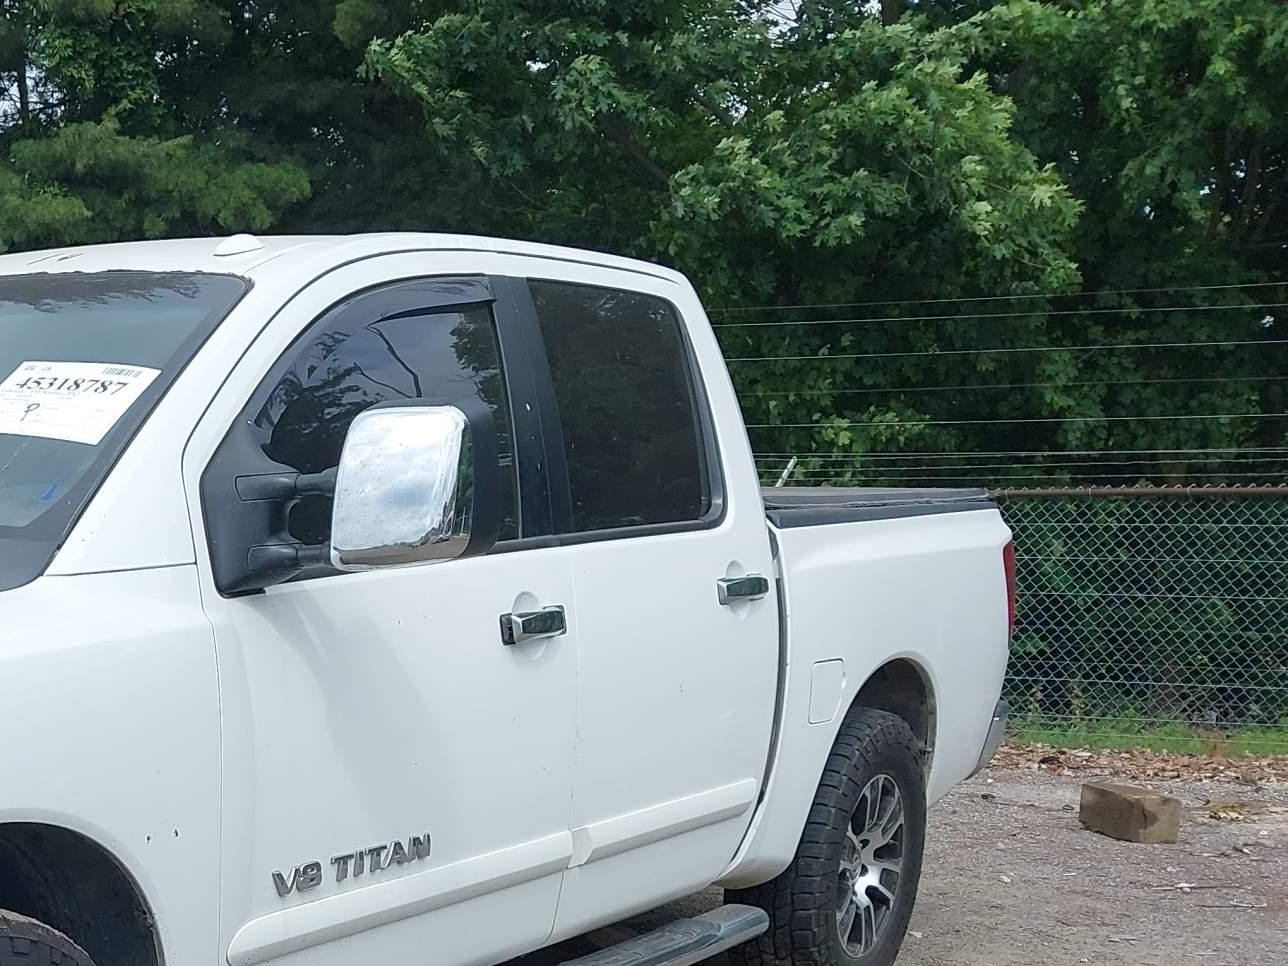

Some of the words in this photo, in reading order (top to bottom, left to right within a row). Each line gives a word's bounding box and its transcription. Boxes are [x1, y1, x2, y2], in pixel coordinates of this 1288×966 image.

[16, 376, 130, 396] 45318787
[271, 860, 323, 897] V8
[330, 832, 432, 882] TITAN
